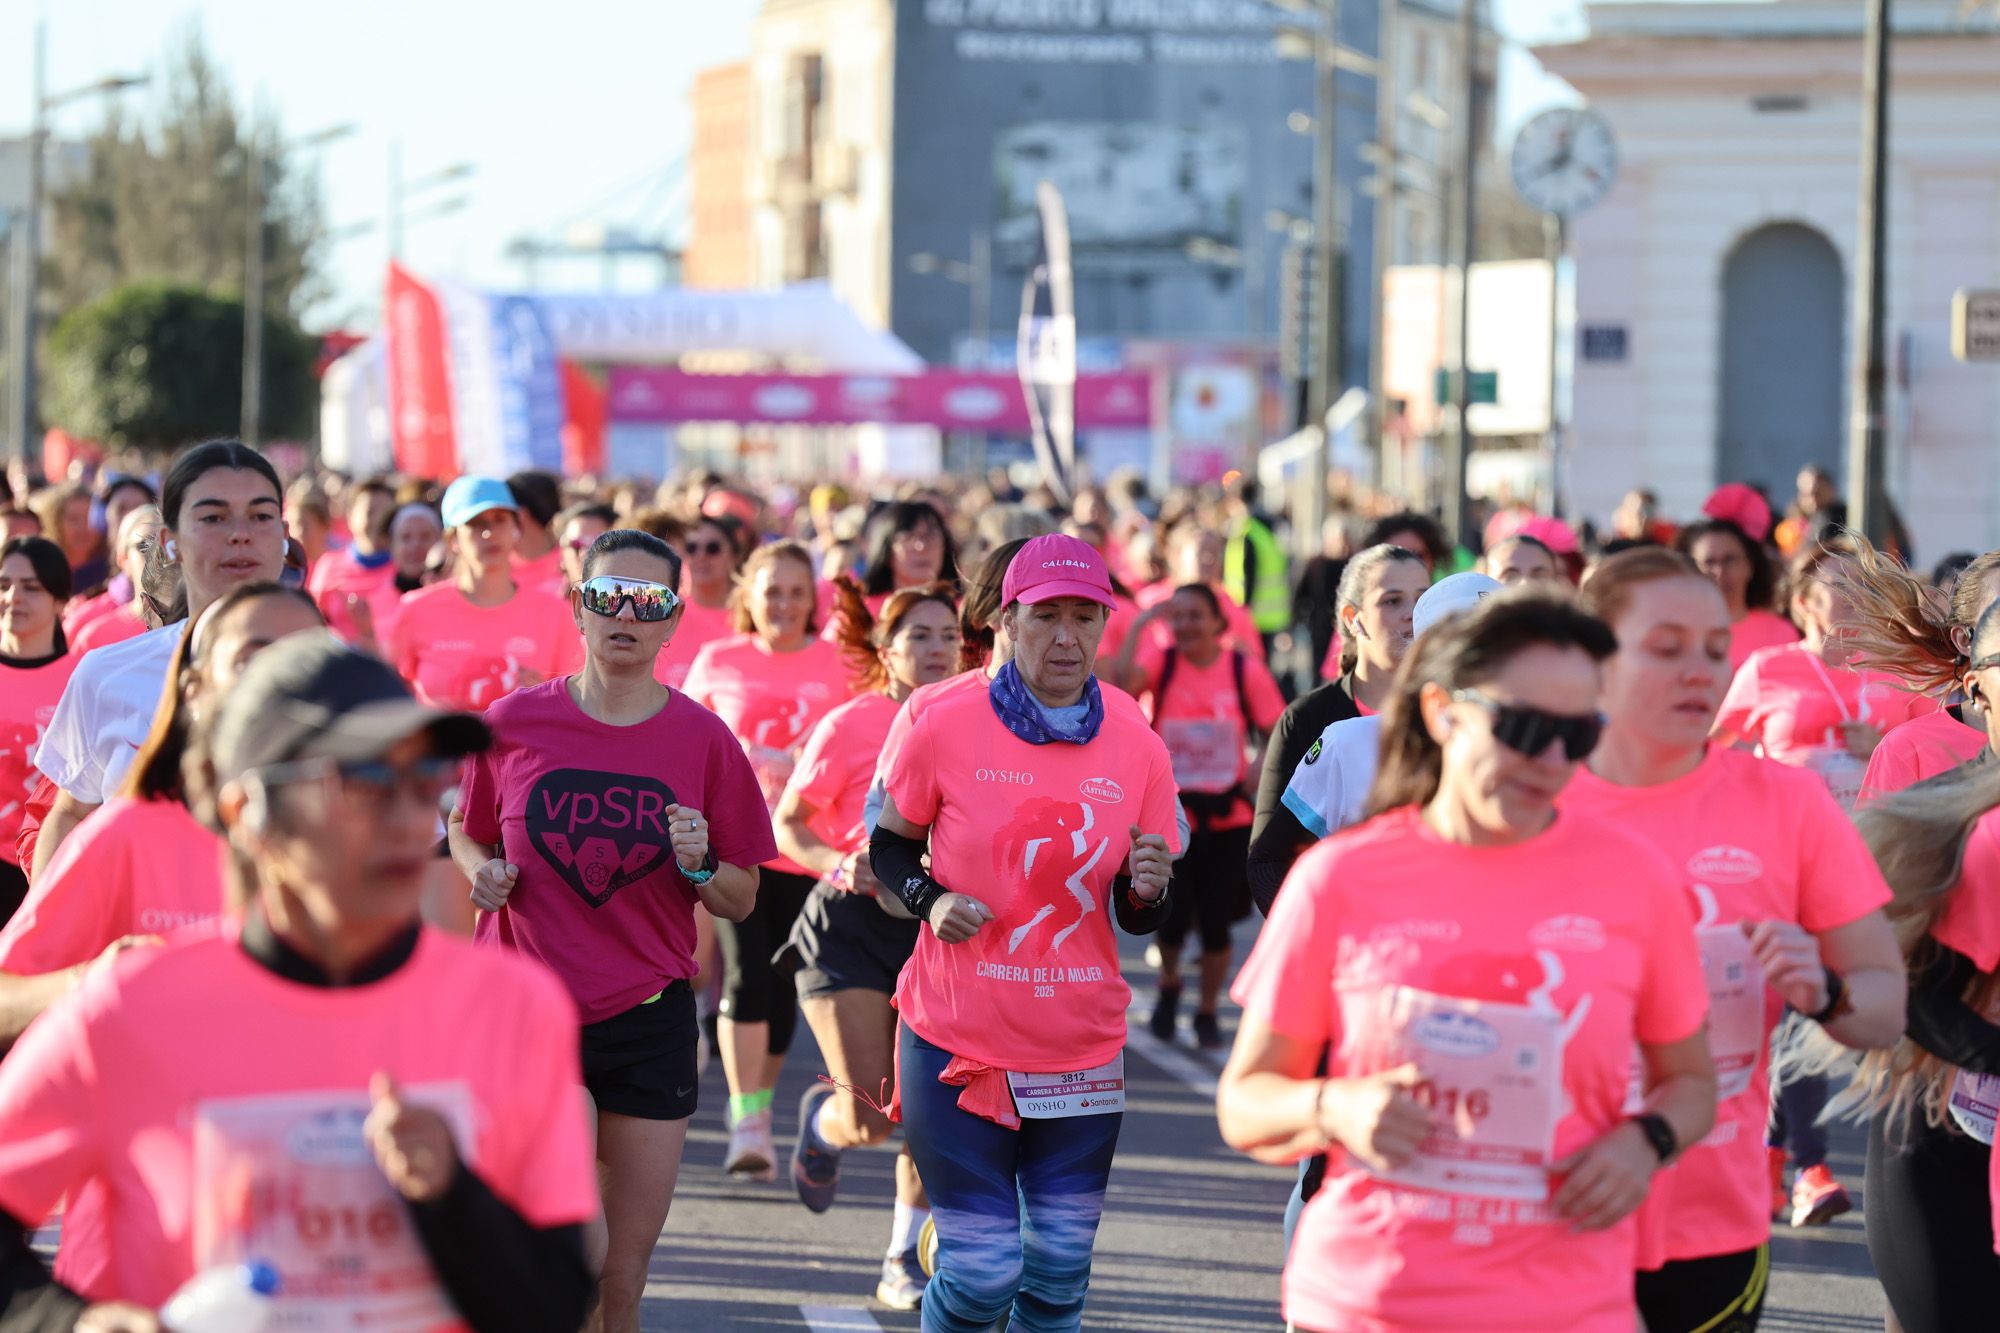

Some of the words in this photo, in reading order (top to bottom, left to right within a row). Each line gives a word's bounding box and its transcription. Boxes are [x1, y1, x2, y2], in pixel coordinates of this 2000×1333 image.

[1041, 559, 1091, 569] CALIBABY
[975, 768, 1034, 786] OYSHO
[542, 786, 666, 834] vpSR
[555, 842, 563, 854] F
[595, 847, 604, 858] S
[637, 851, 646, 863] F
[976, 961, 1029, 982] CARRERA
[1033, 967, 1047, 982] DE
[1050, 967, 1064, 982] LA
[1068, 966, 1104, 982] MUJER
[1034, 985, 1055, 998] 2025
[1061, 1072, 1085, 1083] 3812
[1026, 1088, 1052, 1096] CARRERA
[1053, 1087, 1061, 1095] DE
[1062, 1086, 1071, 1094] LA
[1072, 1085, 1092, 1093] MUJER
[1027, 1100, 1066, 1112] OYSHO
